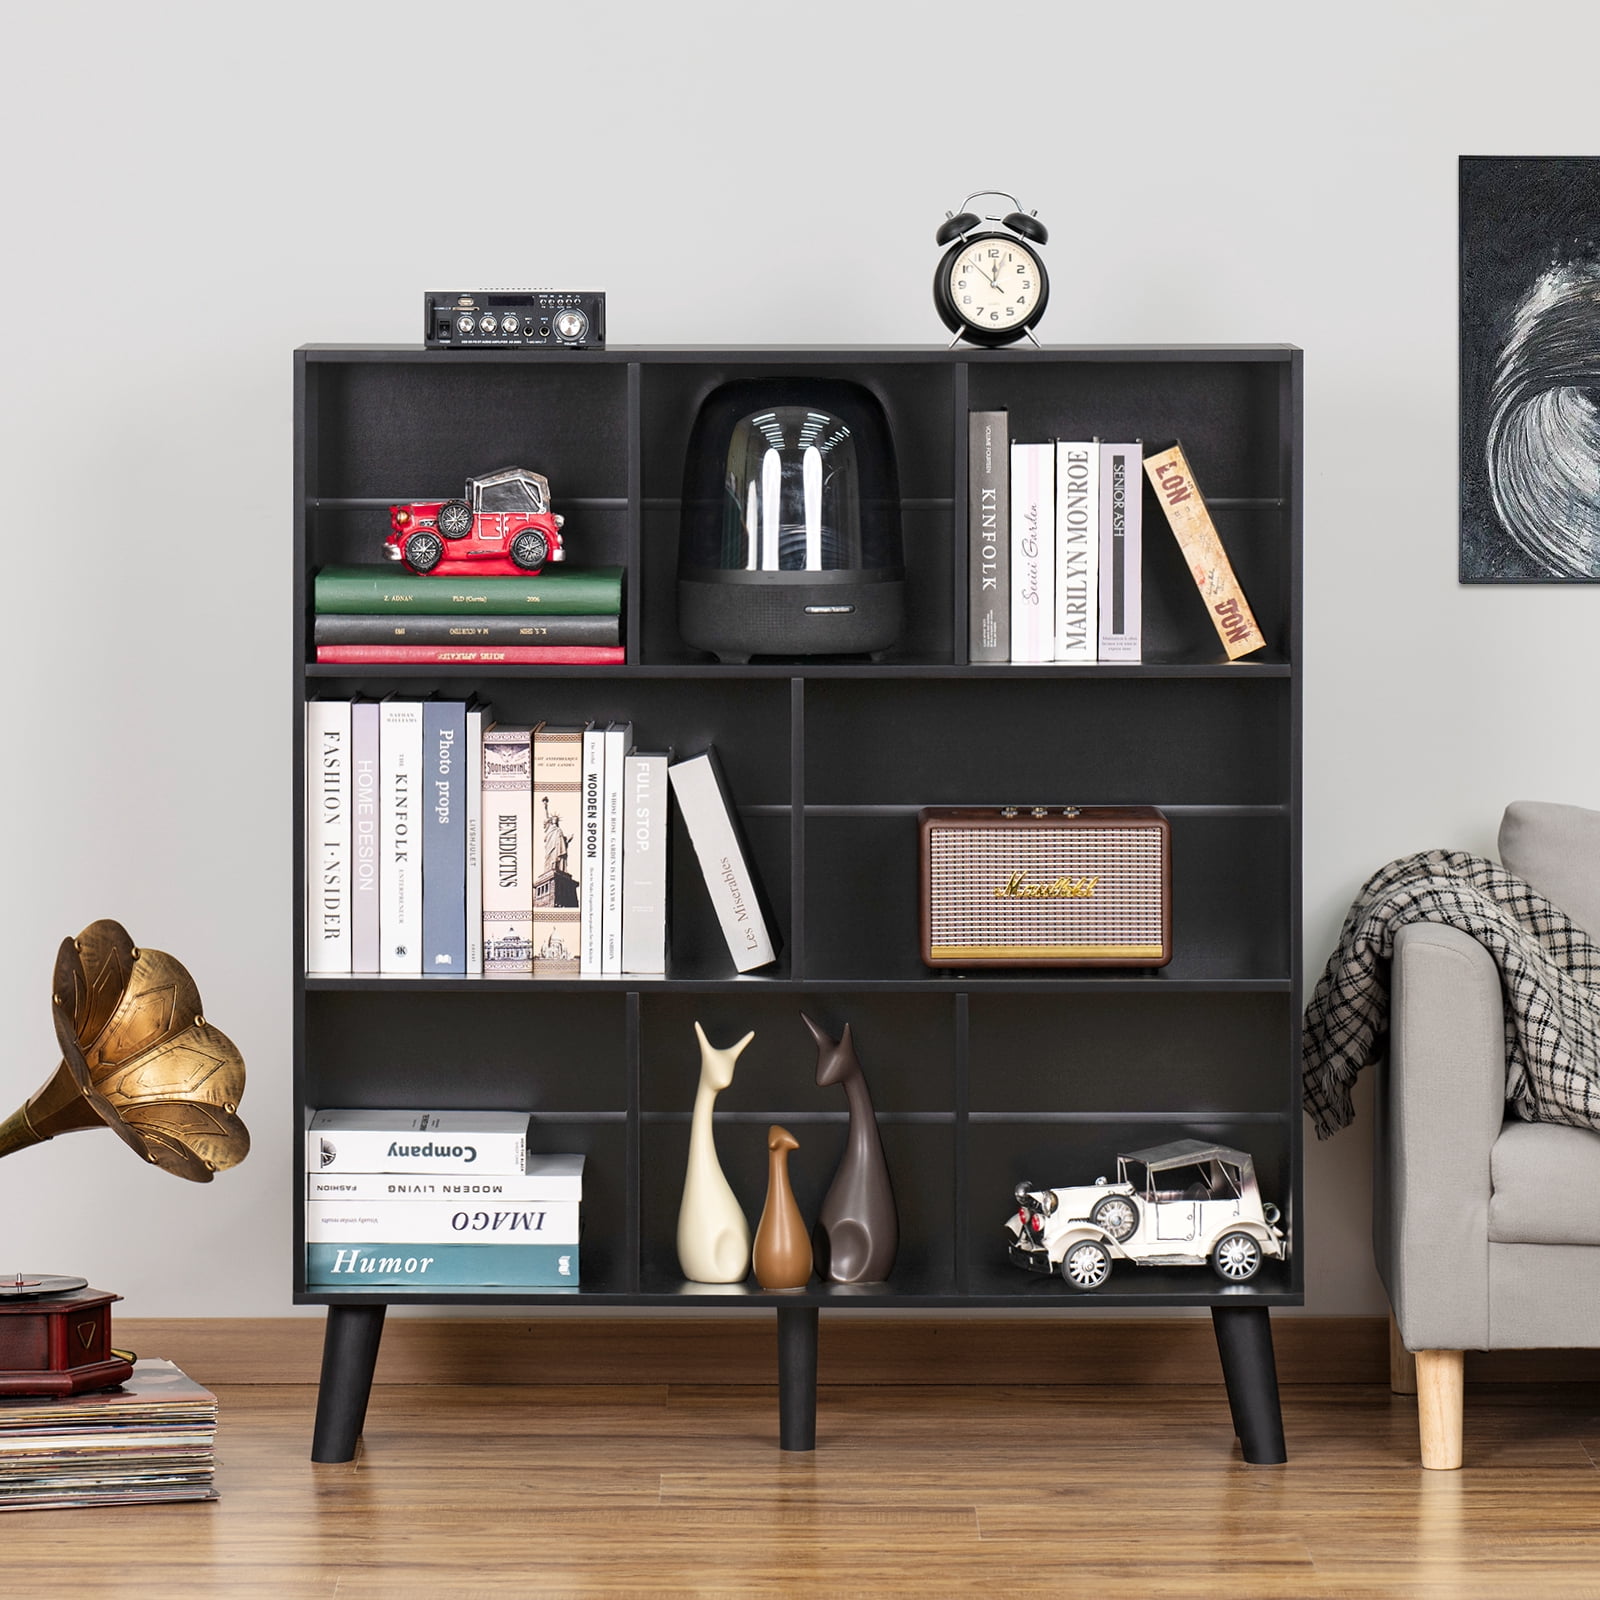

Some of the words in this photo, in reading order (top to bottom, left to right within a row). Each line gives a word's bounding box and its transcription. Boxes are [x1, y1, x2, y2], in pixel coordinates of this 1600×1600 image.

[988, 249, 999, 258] 12
[1016, 265, 1025, 274] 2
[958, 280, 967, 289] 9
[963, 295, 972, 304] 8
[1016, 296, 1026, 304] 4
[1022, 280, 1031, 289] 3
[976, 307, 985, 316] 7
[990, 312, 999, 321] 6
[1006, 307, 1015, 316] 5
[1067, 450, 1089, 545] MONROE
[1113, 463, 1125, 508] SENIOR
[982, 487, 997, 591] KINFOLK
[1021, 503, 1039, 558] Garden
[1113, 510, 1125, 538] ASH
[1066, 550, 1087, 650] MARILYN
[1214, 598, 1250, 645] DON
[439, 729, 454, 775] Photo
[323, 731, 341, 825] FASHION
[357, 759, 374, 815] HOME
[636, 762, 651, 804] FULL
[435, 780, 450, 824] props
[587, 773, 597, 819] WOODEN
[395, 773, 408, 863] KINFOLK
[635, 807, 650, 854] STOP.
[586, 822, 597, 858] SPOON
[719, 856, 749, 922] Miserables
[744, 927, 759, 951] Les
[387, 1141, 477, 1163] Company
[387, 1185, 435, 1193] LIVING
[442, 1185, 503, 1193] MODERN
[451, 1211, 547, 1231] IMAGO
[330, 1249, 434, 1274] Humor
